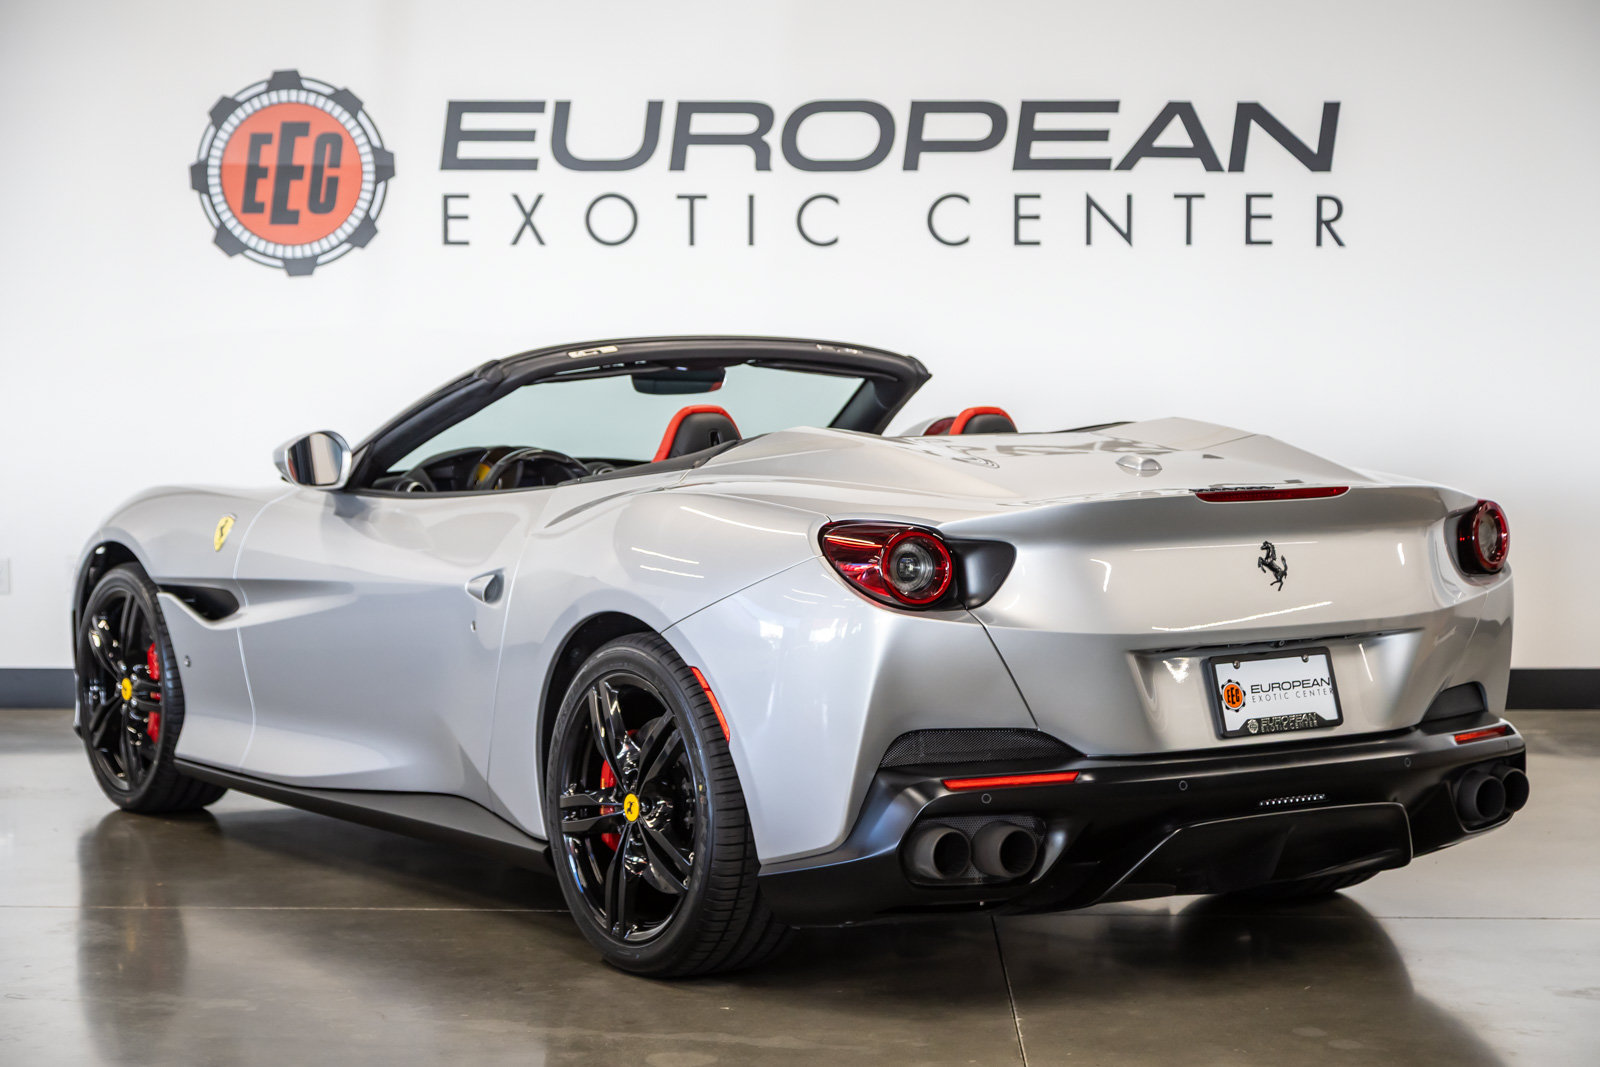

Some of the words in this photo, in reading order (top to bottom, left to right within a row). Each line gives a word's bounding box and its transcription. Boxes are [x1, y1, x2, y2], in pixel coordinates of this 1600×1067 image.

[440, 100, 1342, 173] EUROPEAN
[241, 121, 343, 225] EEC
[443, 193, 839, 247] EXOTIC
[927, 193, 1345, 247] CENTER
[1250, 677, 1331, 693] EUROPEAN
[1226, 687, 1240, 705] EEC
[1252, 692, 1289, 703] EXOTIC
[1296, 688, 1334, 698] CENTER
[1261, 712, 1317, 726] EUROPEAN
